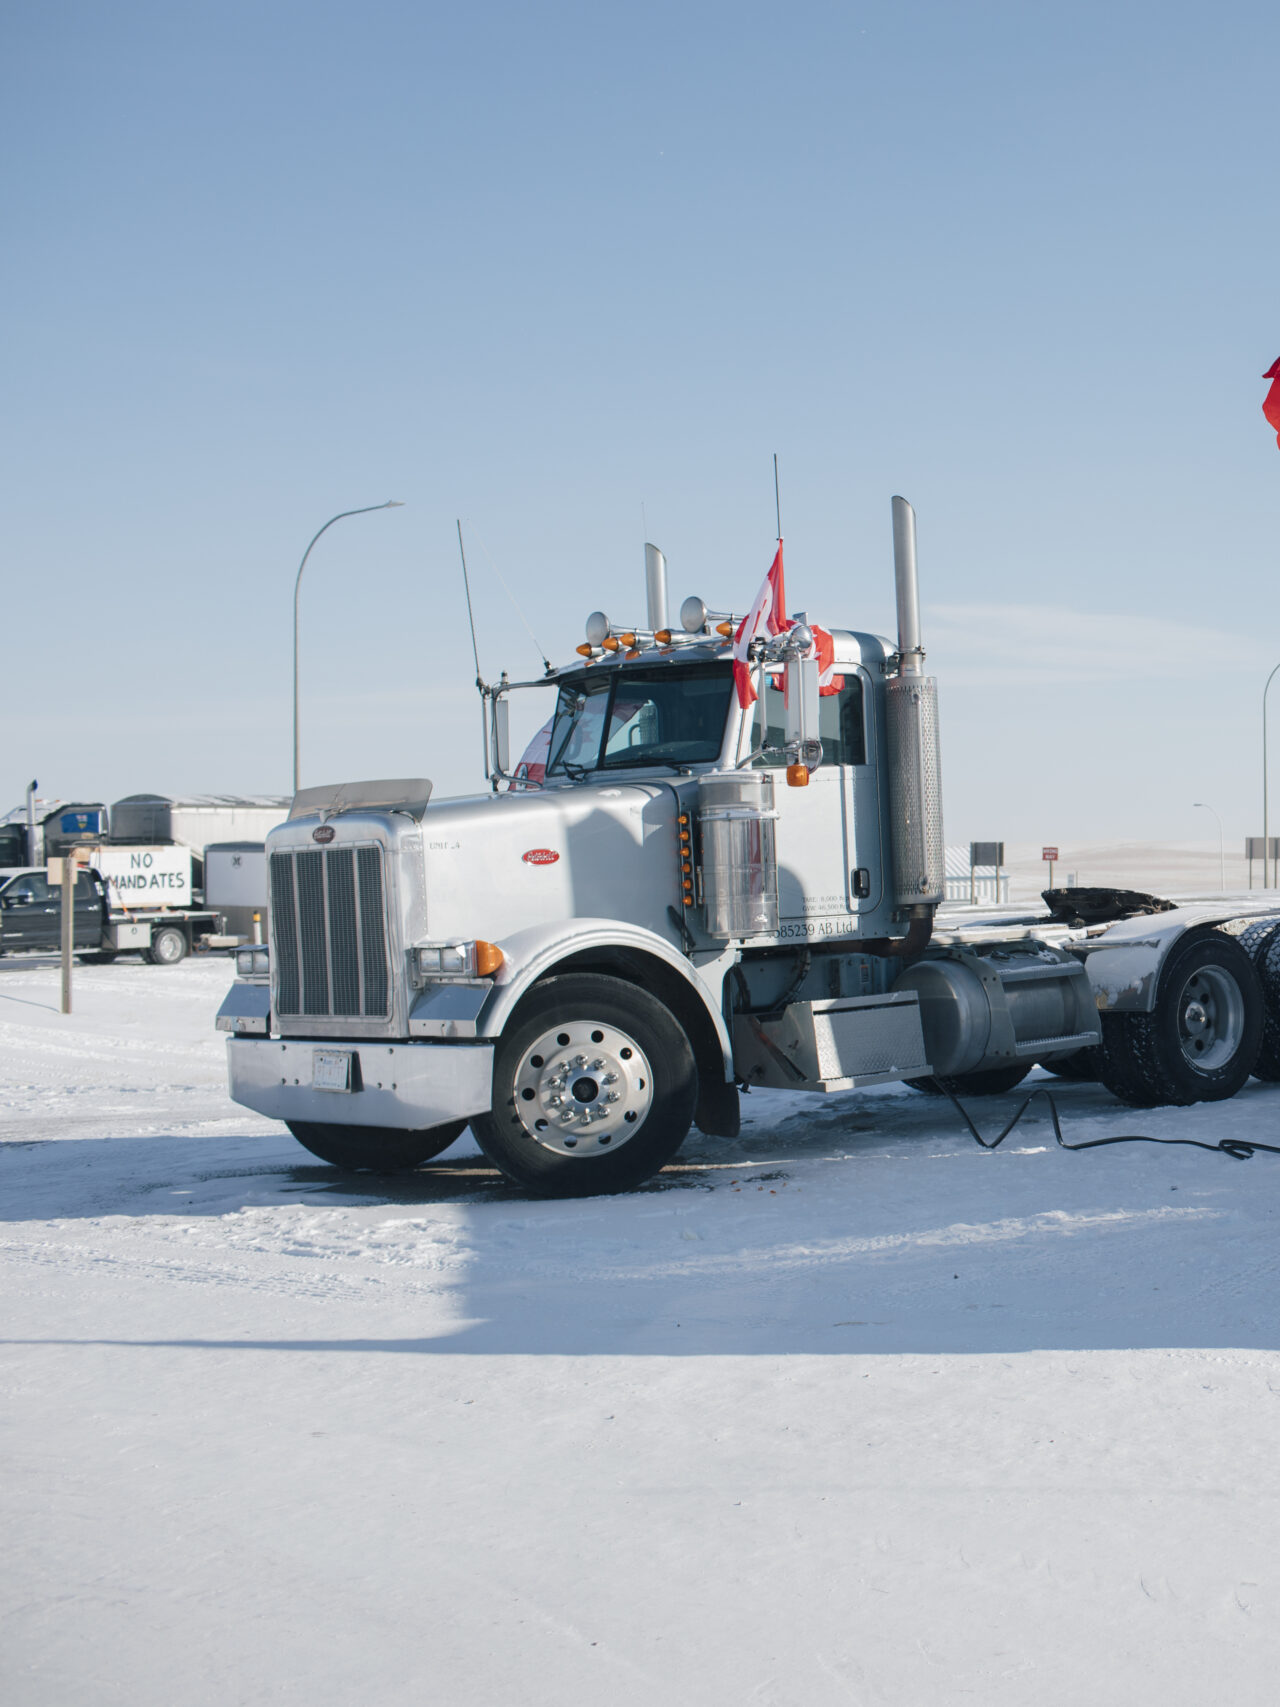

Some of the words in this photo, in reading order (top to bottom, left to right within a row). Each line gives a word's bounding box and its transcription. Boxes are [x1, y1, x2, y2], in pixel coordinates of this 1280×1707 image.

[130, 853, 153, 869] NO
[107, 872, 185, 890] MANDATES
[819, 922, 833, 935] AB
[836, 920, 857, 934] Ltd.
